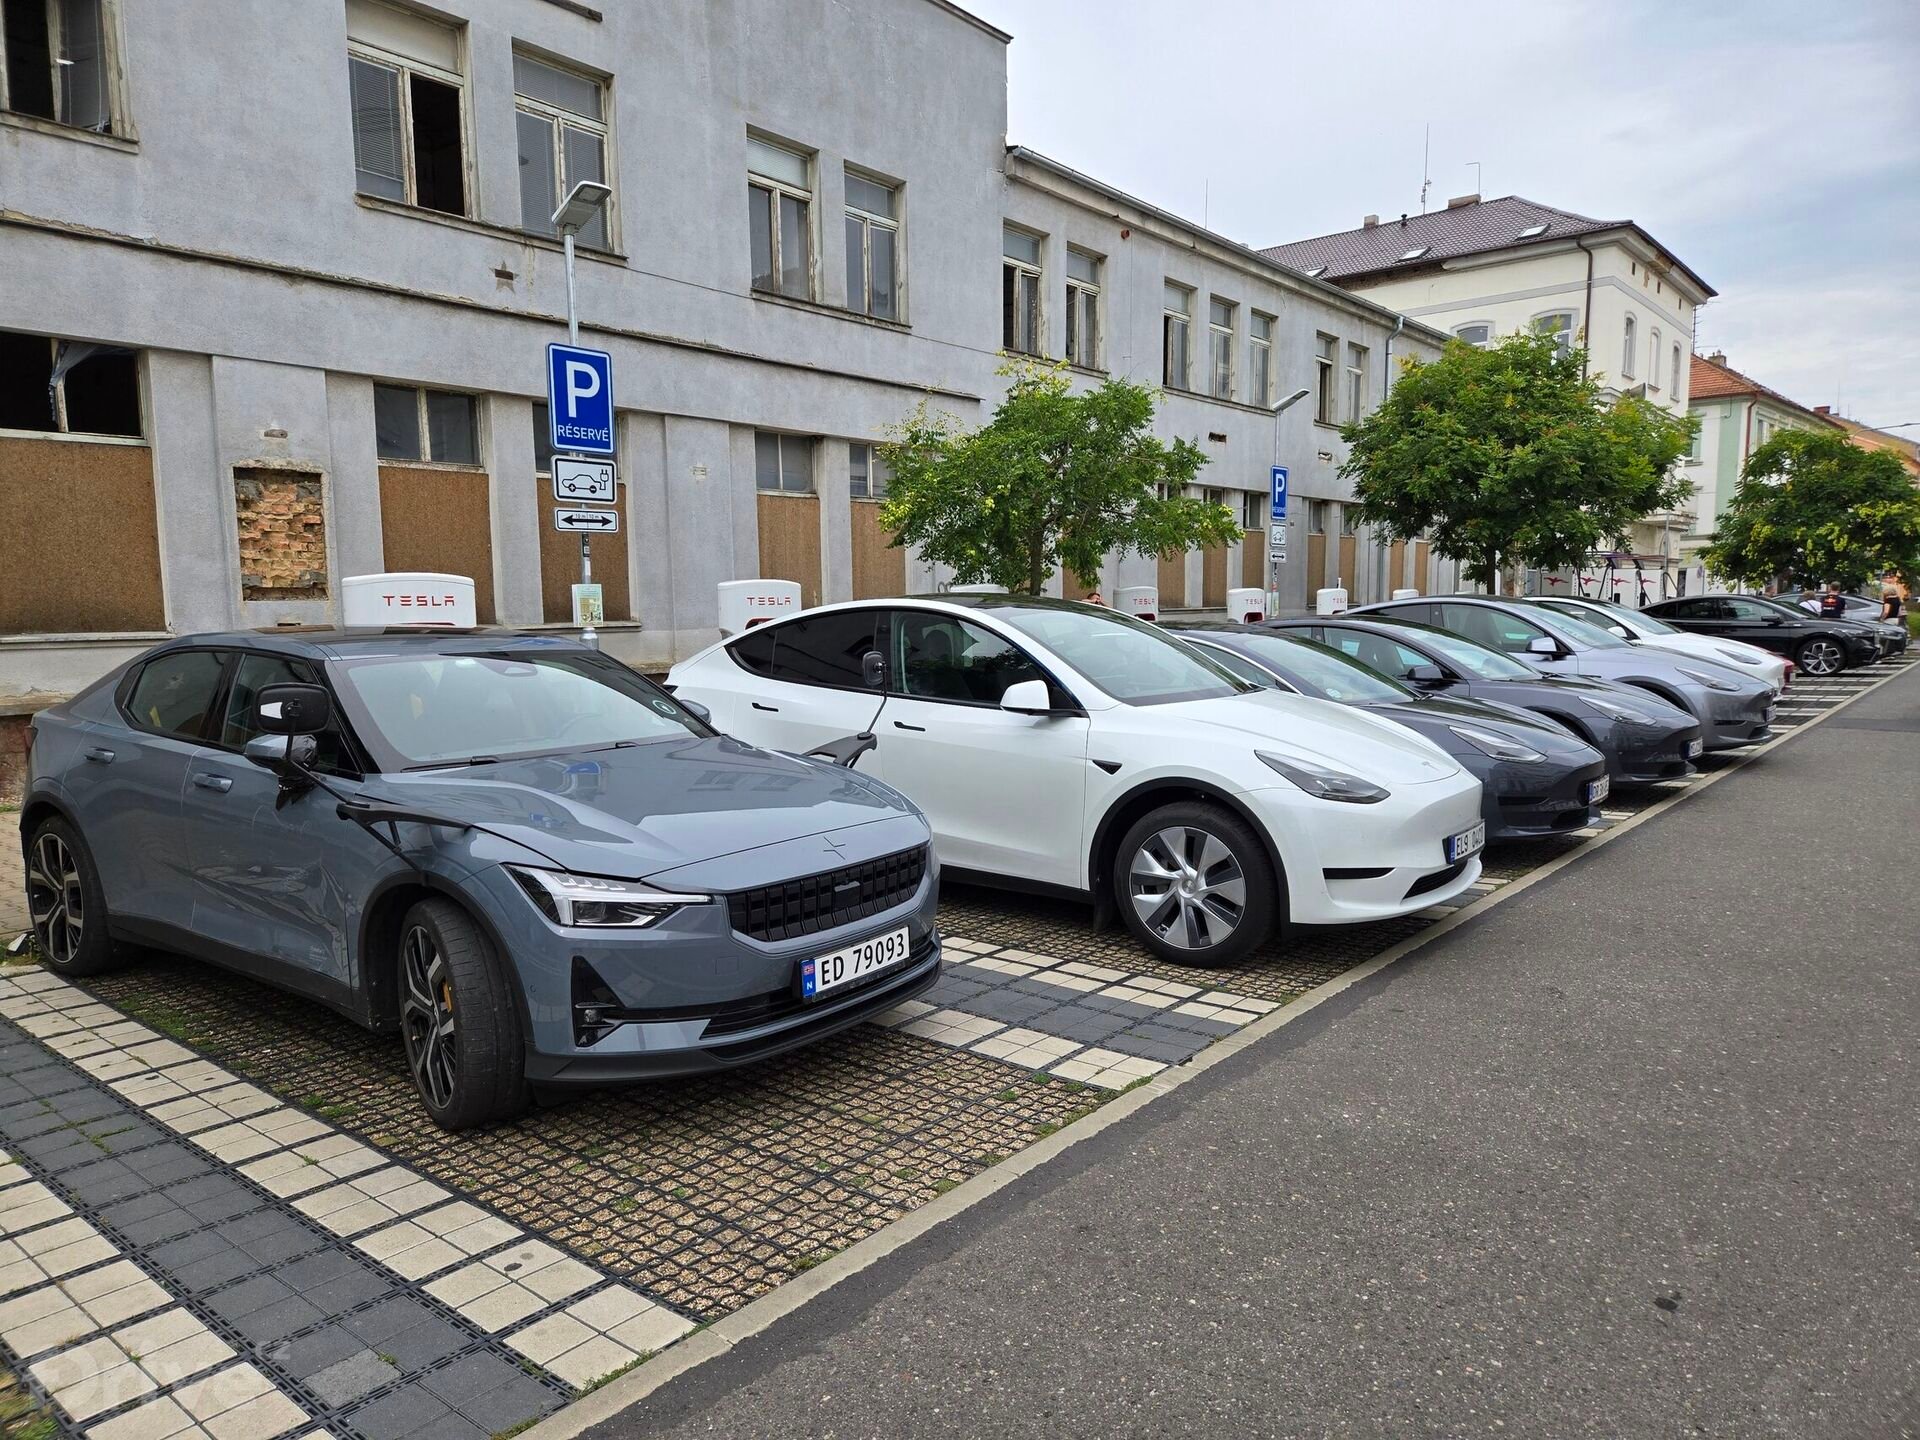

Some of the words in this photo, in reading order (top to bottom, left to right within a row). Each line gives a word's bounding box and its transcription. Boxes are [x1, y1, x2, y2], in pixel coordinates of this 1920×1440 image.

[566, 360, 600, 418] P
[558, 423, 609, 442] RÉSERVÉ
[1275, 473, 1285, 503] P
[382, 595, 455, 607] TESLA
[746, 596, 792, 606] TESLA
[821, 955, 845, 986] ED
[853, 933, 905, 974] 79093
[806, 981, 813, 990] N
